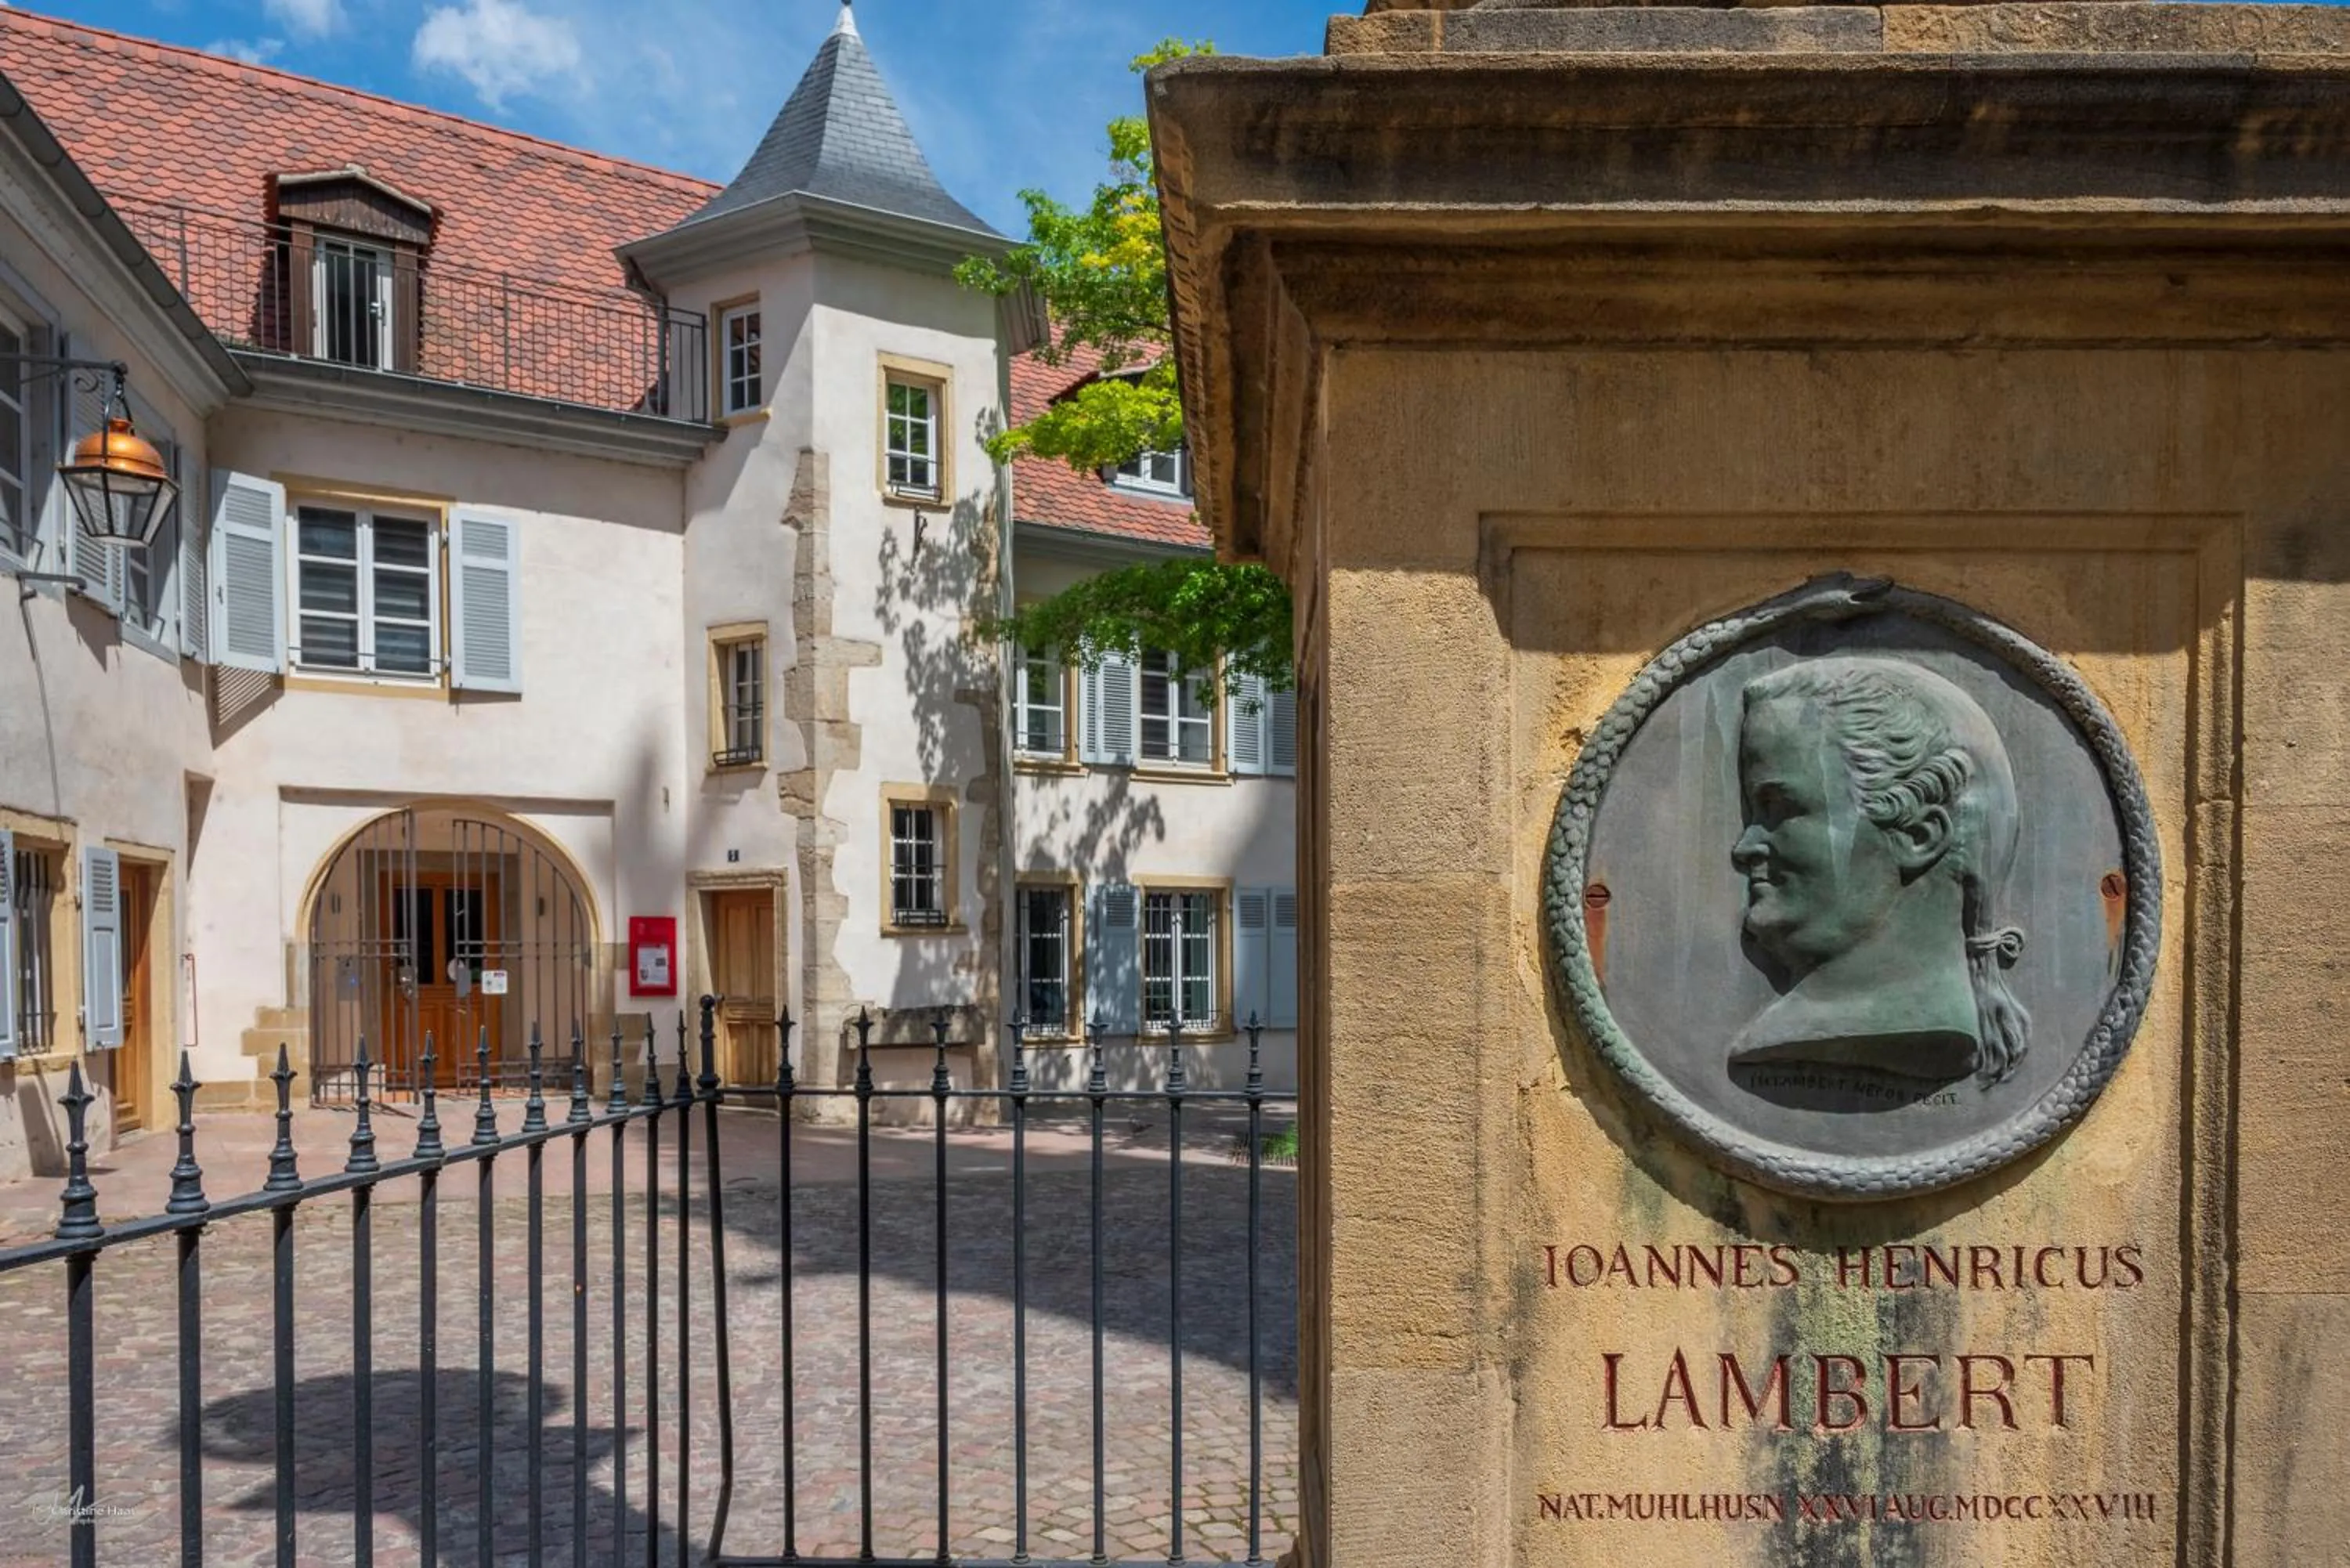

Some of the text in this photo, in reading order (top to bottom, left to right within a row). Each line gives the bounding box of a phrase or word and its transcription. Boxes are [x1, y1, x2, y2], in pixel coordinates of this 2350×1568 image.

[1541, 1241, 2145, 1291] IOANNES HENRICUS
[1600, 1346, 2095, 1433] LAMBERT
